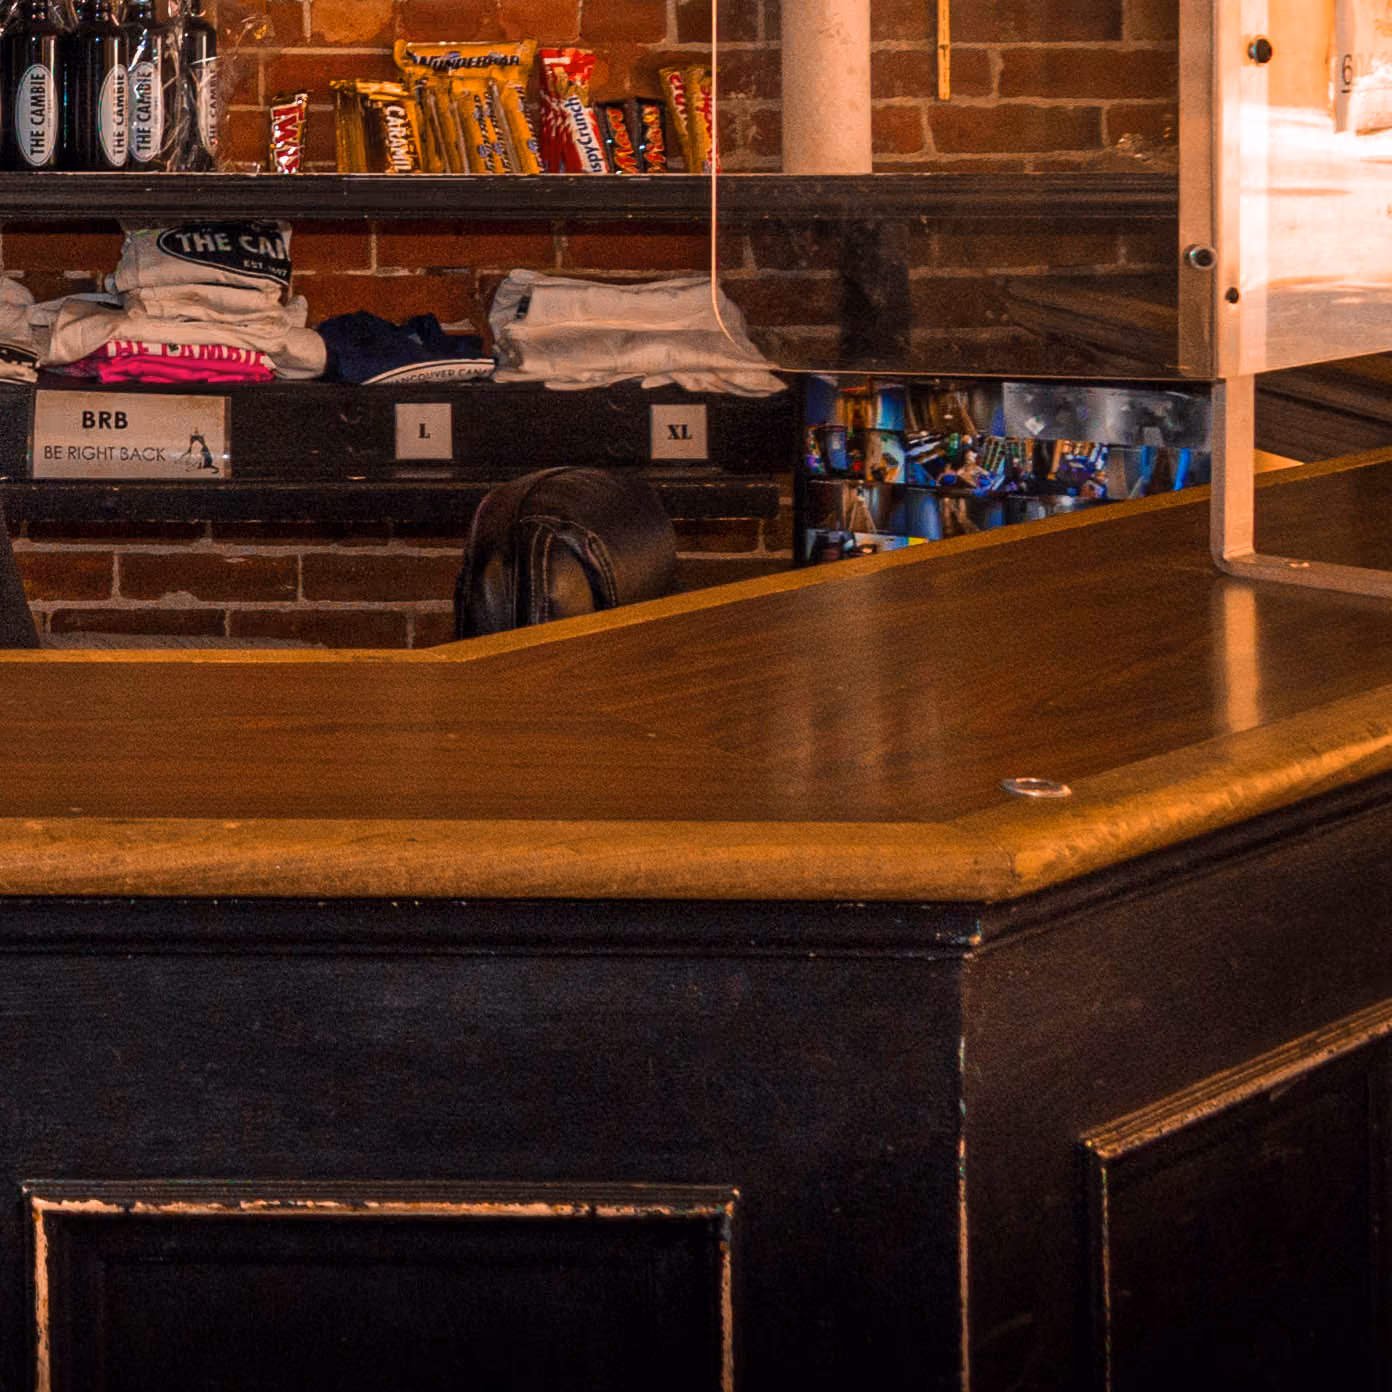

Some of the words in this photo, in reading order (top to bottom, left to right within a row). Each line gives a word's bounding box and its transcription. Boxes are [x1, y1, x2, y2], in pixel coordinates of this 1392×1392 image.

[30, 73, 46, 126] CAMBIE
[113, 73, 125, 126] CAMBIE
[30, 130, 46, 156] THE
[113, 129, 125, 156] THE
[136, 127, 152, 152] THE
[385, 105, 413, 171] CARAMIL
[176, 231, 232, 253] THE
[458, 367, 490, 378] CANA
[82, 410, 129, 430] BRB
[419, 423, 431, 439] L
[667, 424, 693, 440] XL
[43, 444, 63, 460] BE
[67, 445, 116, 461] RIGHT
[119, 446, 167, 462] BACK
